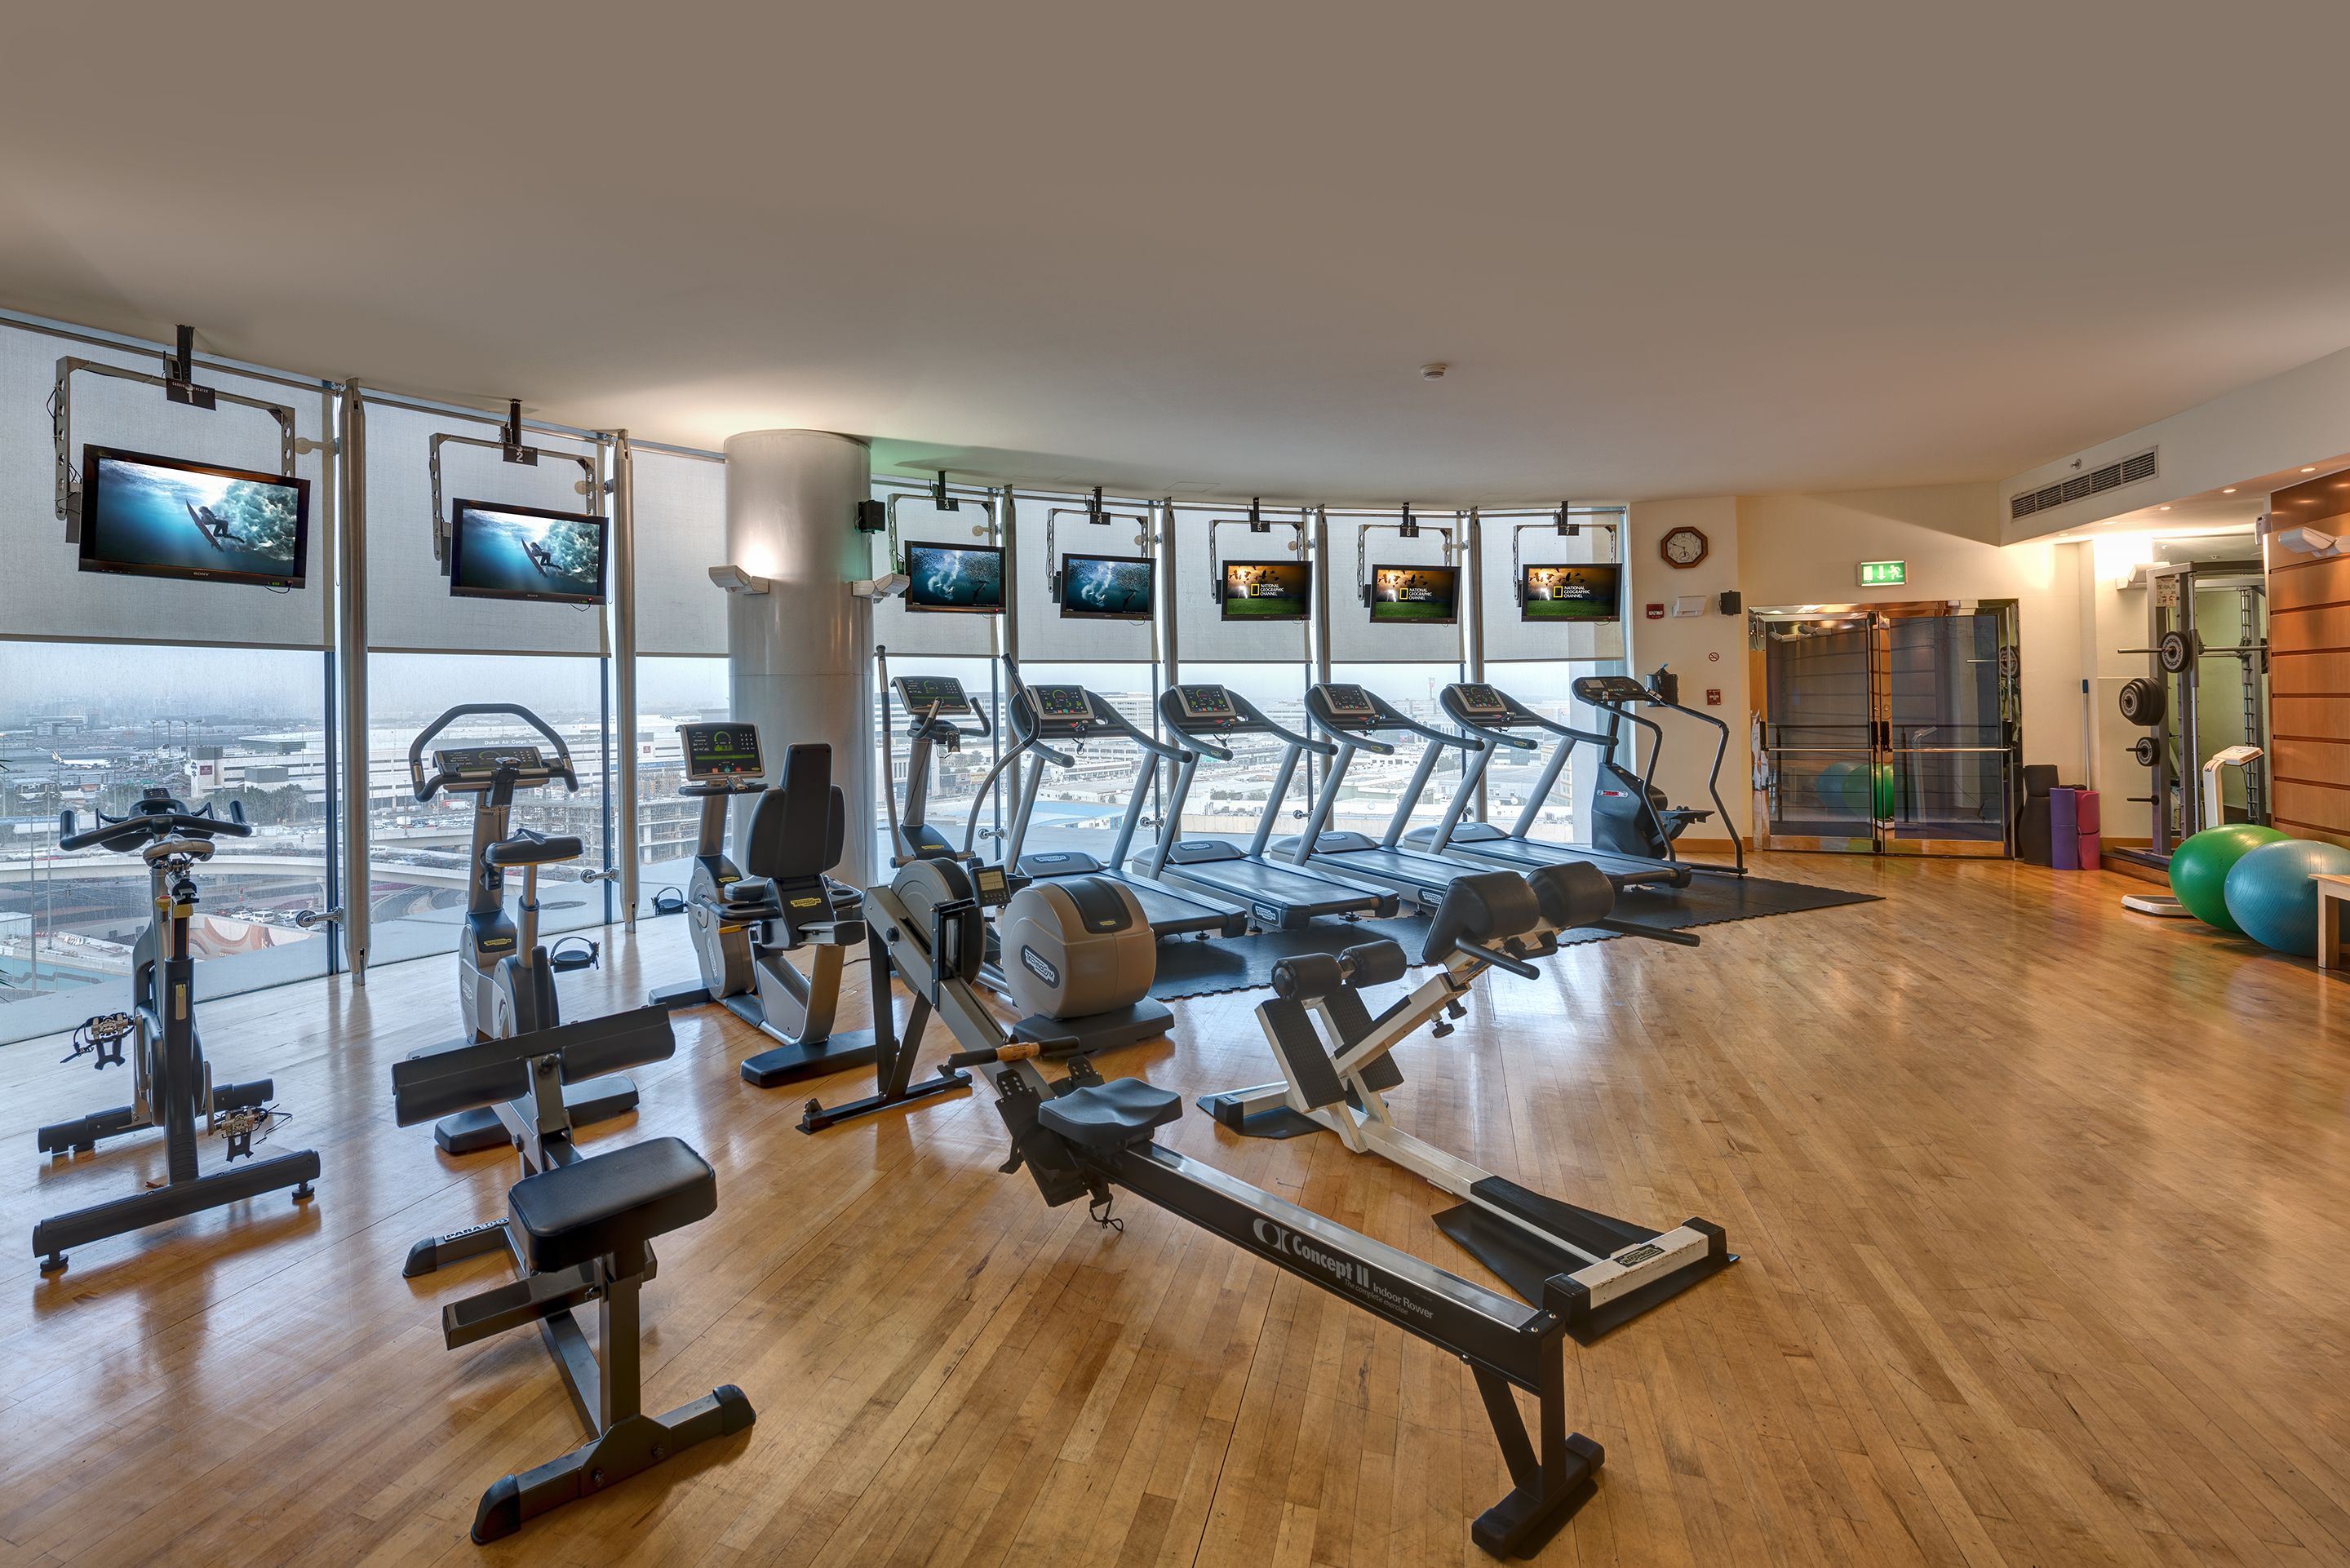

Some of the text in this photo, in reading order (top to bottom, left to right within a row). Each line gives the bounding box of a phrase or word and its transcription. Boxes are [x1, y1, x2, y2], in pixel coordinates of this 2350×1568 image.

[187, 391, 193, 404] 1
[516, 451, 524, 463] 2
[944, 502, 950, 510] 3
[1025, 948, 1055, 982] TECHNOGYM
[1292, 1234, 1353, 1279] Concept
[1345, 1278, 1409, 1316] The complete exercise
[1372, 1282, 1402, 1304] Indoor
[1403, 1296, 1434, 1319] Rower
